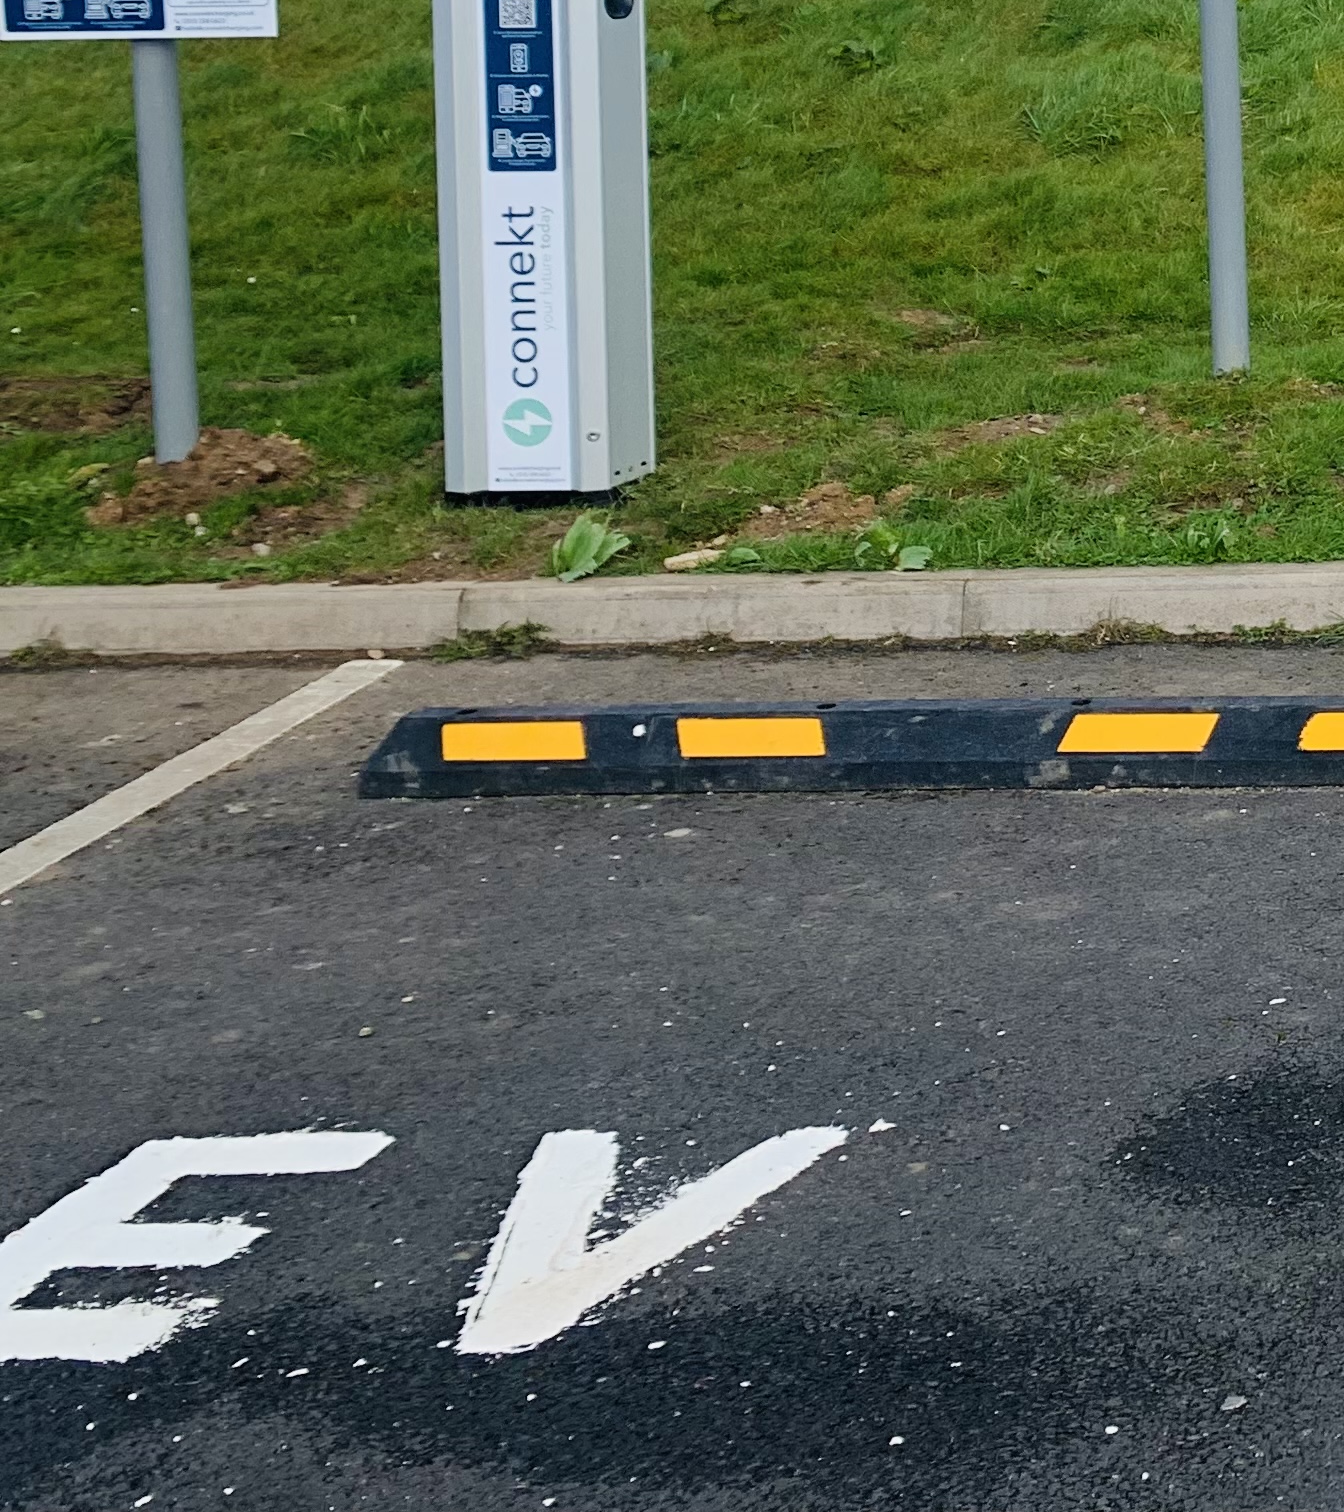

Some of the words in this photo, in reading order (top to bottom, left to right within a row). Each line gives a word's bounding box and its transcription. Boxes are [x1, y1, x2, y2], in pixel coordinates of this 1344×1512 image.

[537, 205, 554, 250] today
[539, 253, 552, 296] future
[494, 206, 539, 388] connekt
[543, 302, 557, 331] your
